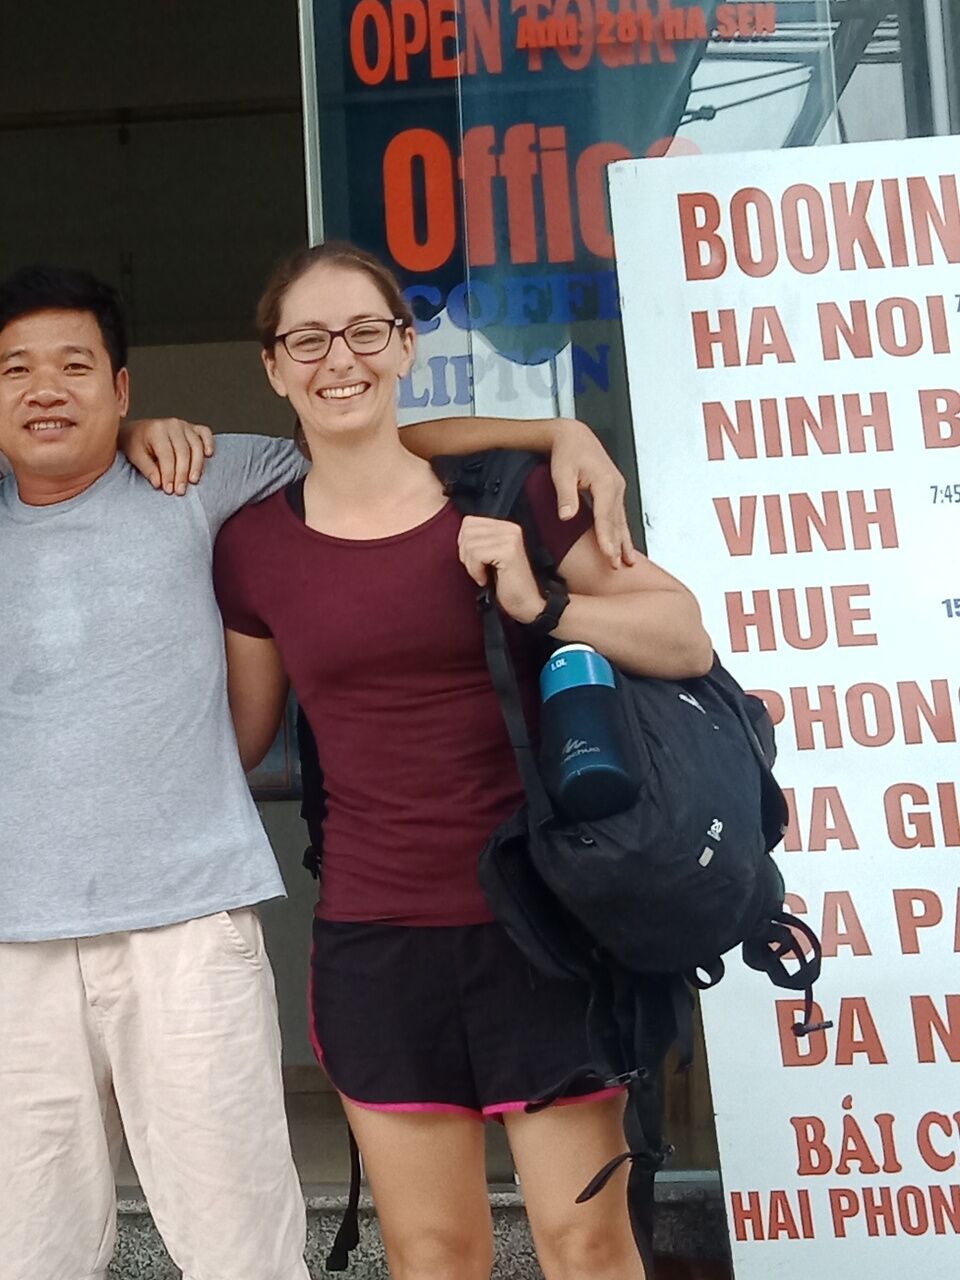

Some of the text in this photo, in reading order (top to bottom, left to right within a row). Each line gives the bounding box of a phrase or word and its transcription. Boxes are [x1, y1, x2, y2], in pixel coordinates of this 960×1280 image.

[716, 2, 777, 37] SEN
[383, 123, 702, 273] Offic
[677, 174, 960, 282] BOOKIN
[691, 305, 795, 369] HA
[817, 295, 951, 360] NOI
[701, 391, 894, 461] NINH
[712, 488, 899, 556] VINH
[724, 584, 878, 653] HUE
[744, 679, 960, 752] PHON
[892, 886, 960, 955] P
[917, 1111, 960, 1172] C
[730, 1184, 960, 1241] HAI PHON
